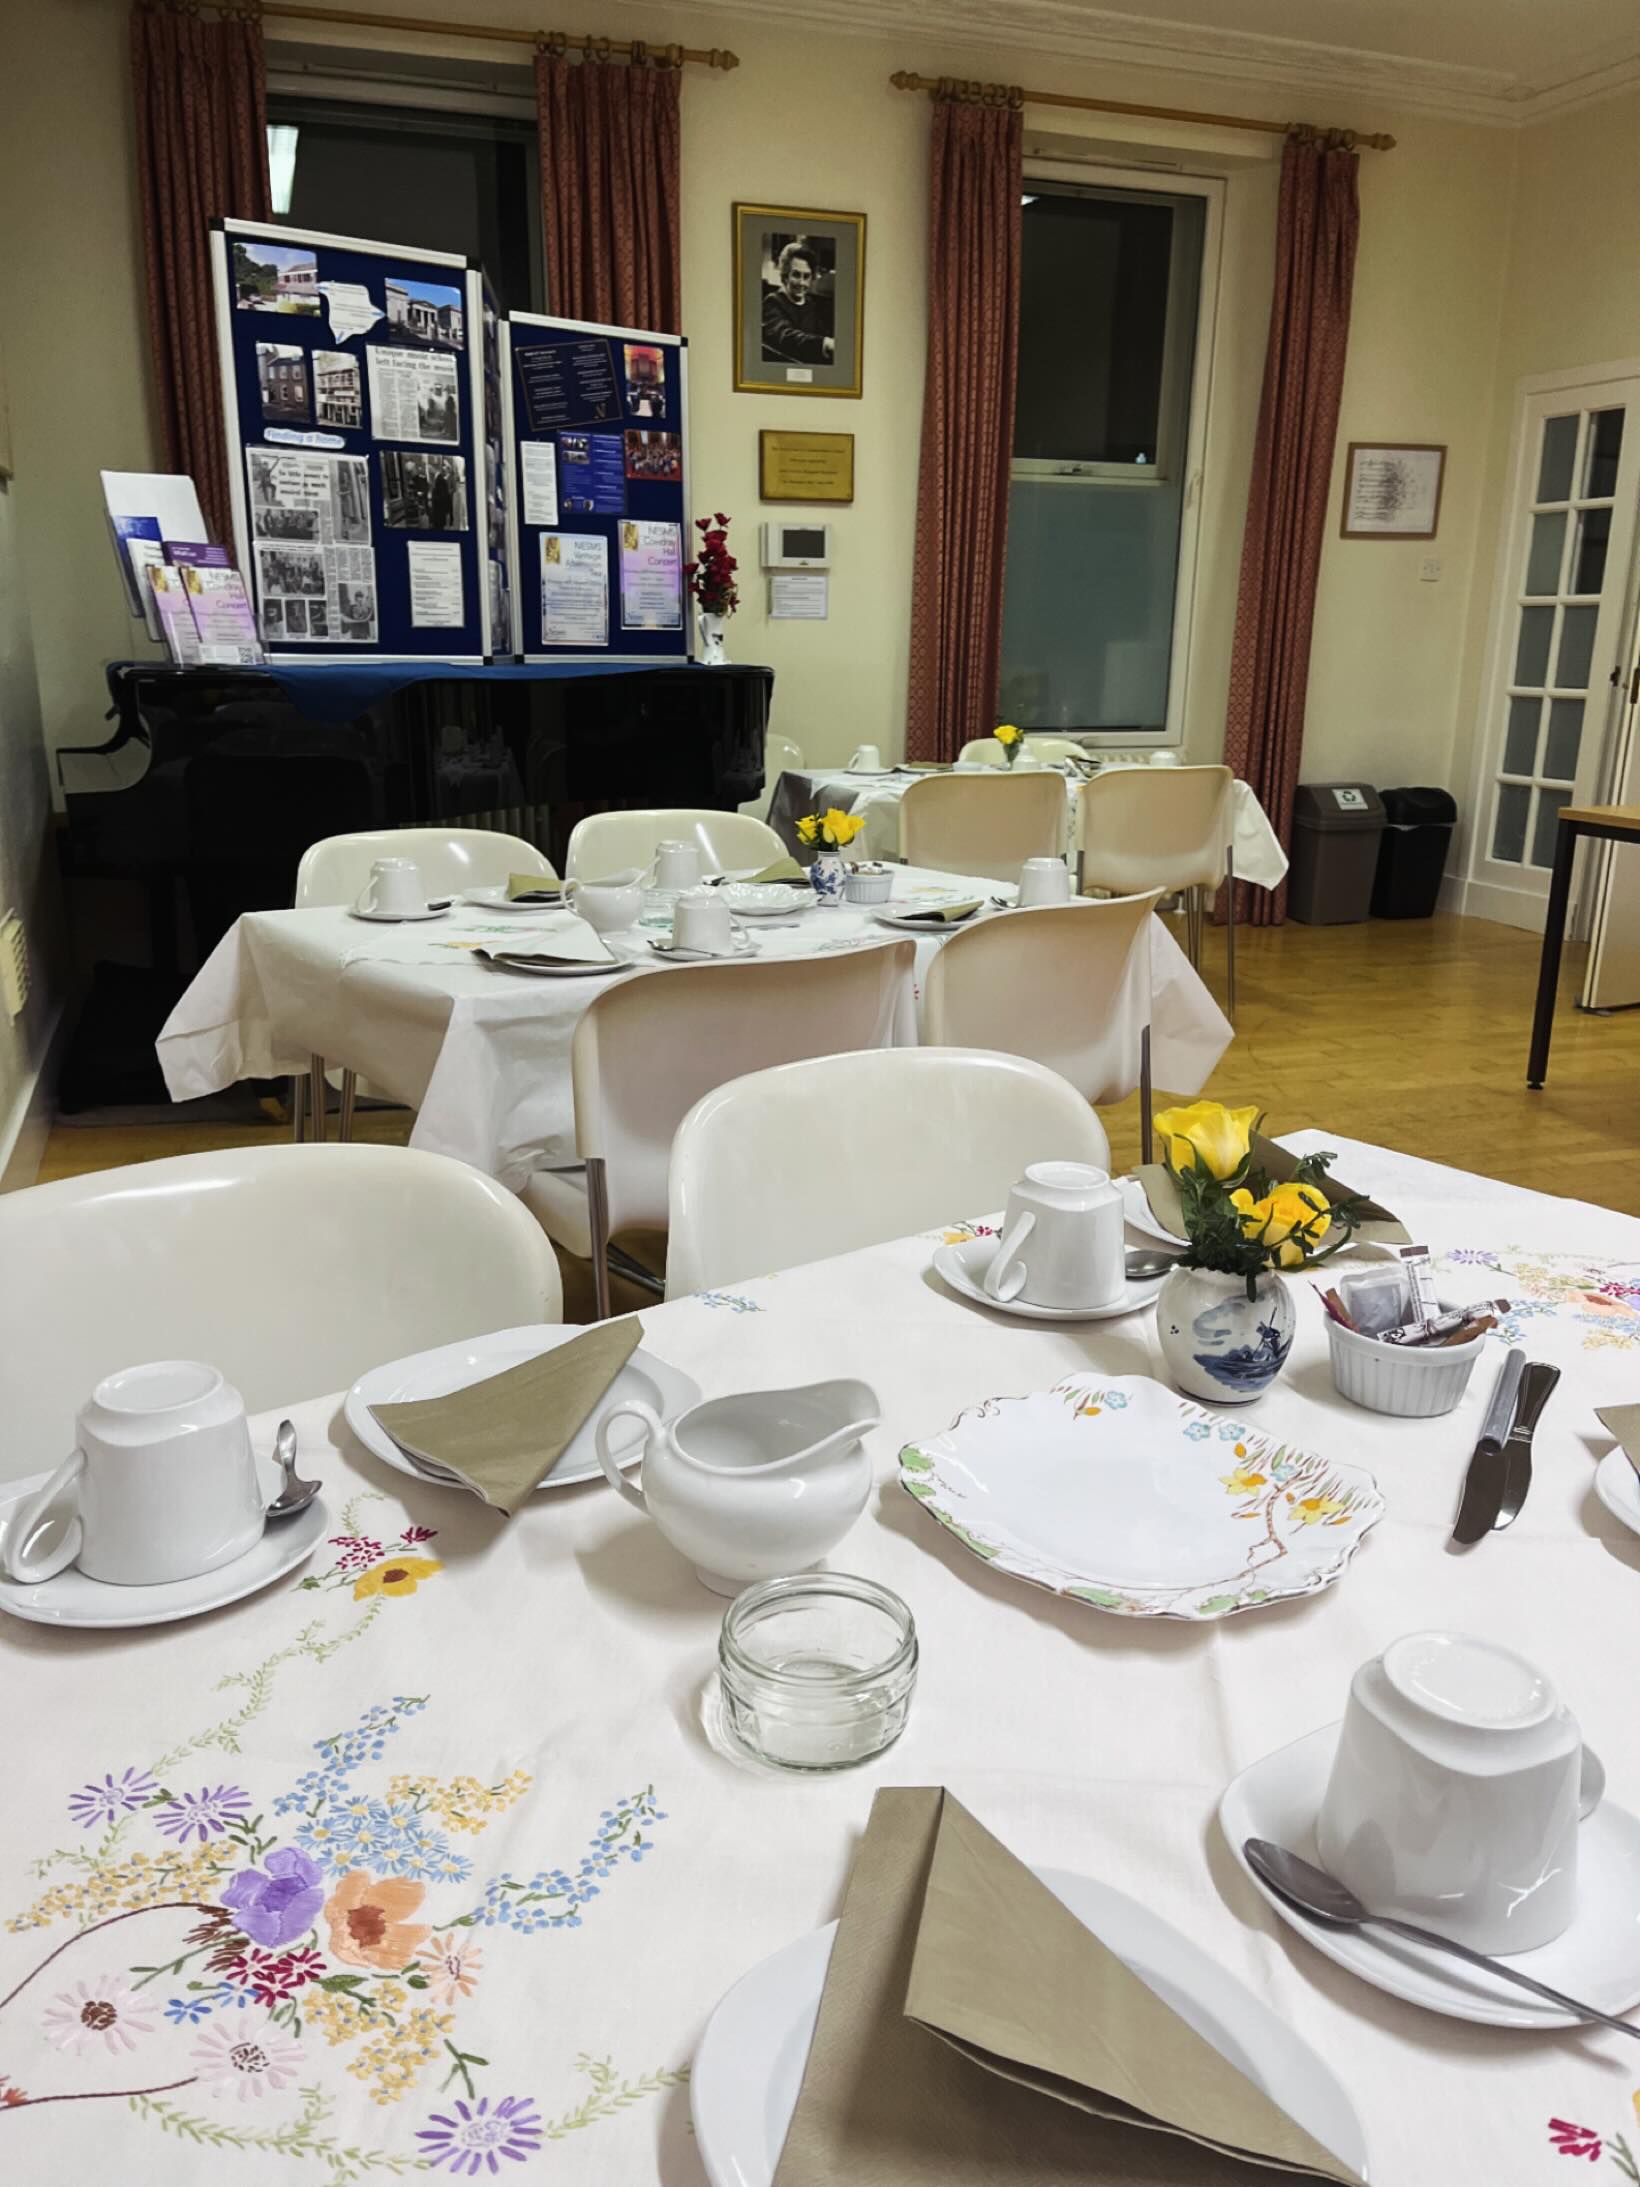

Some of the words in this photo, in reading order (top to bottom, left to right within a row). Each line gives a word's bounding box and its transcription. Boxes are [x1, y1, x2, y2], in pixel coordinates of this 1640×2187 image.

[391, 359, 416, 370] facing
[418, 361, 430, 370] the
[647, 557, 677, 566] Concert
[216, 600, 247, 609] Concert
